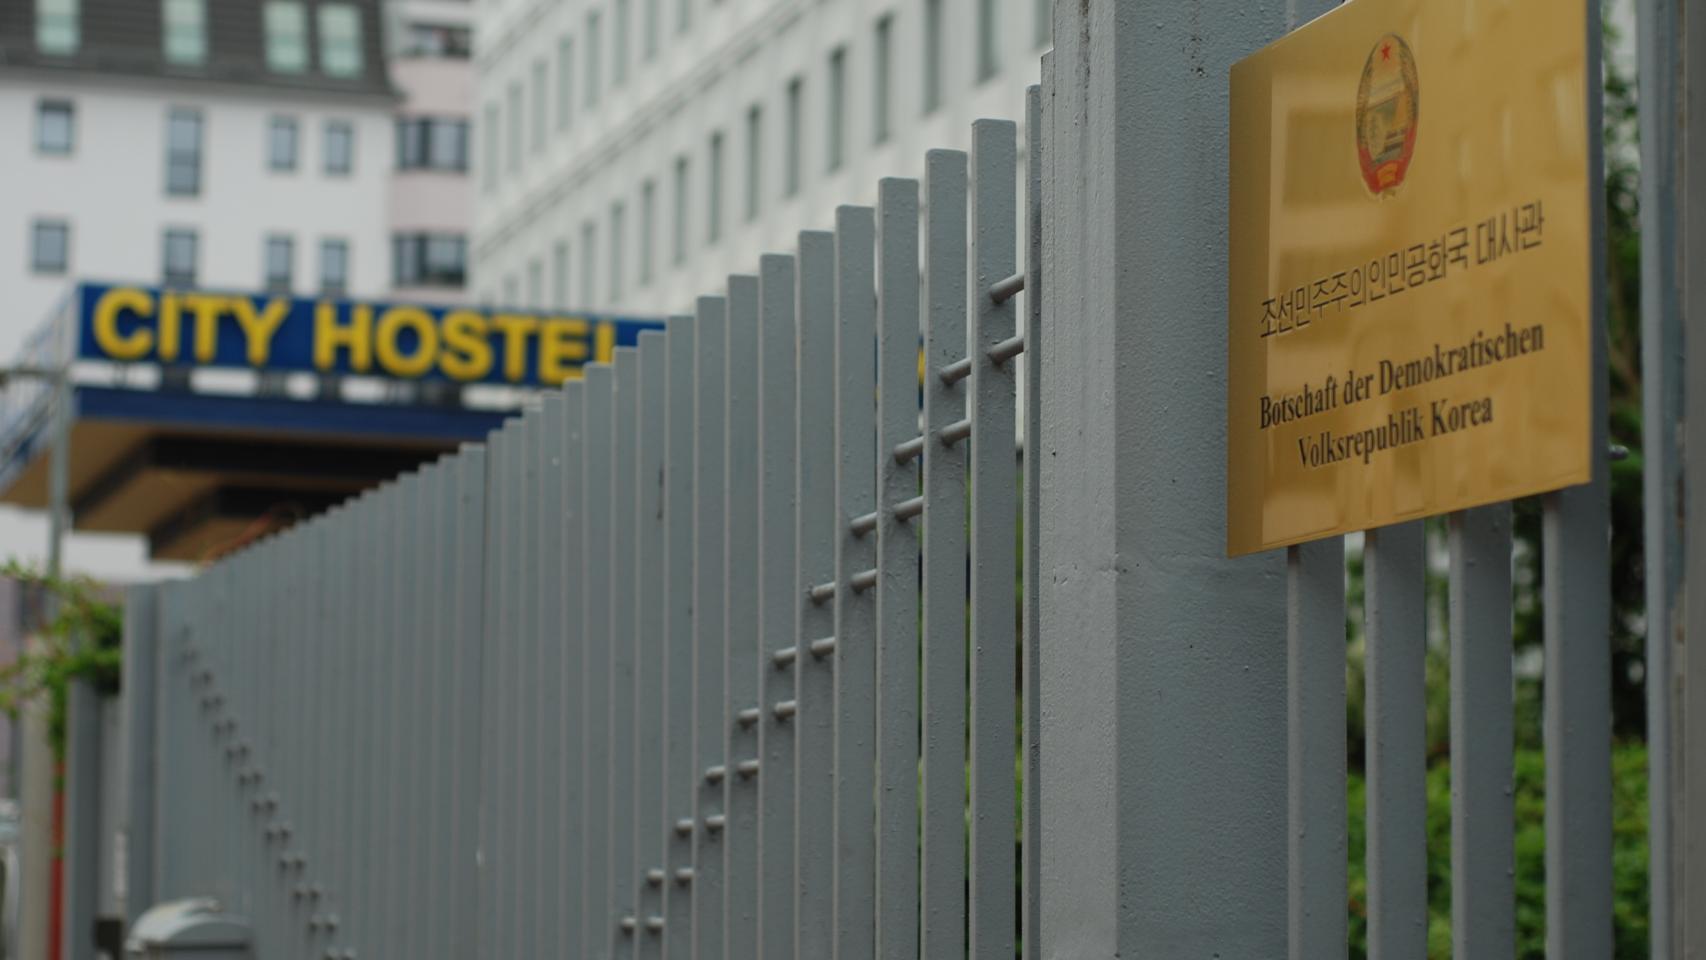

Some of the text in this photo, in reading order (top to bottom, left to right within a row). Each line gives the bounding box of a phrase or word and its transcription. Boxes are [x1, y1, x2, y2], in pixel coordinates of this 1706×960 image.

[1259, 199, 1545, 339] 조선민주주의인민공화국 대사관
[92, 287, 292, 366] CITY
[1259, 323, 1544, 430] Botschaft der Demokratischen
[1298, 396, 1493, 469] Volksrepublik Korea
